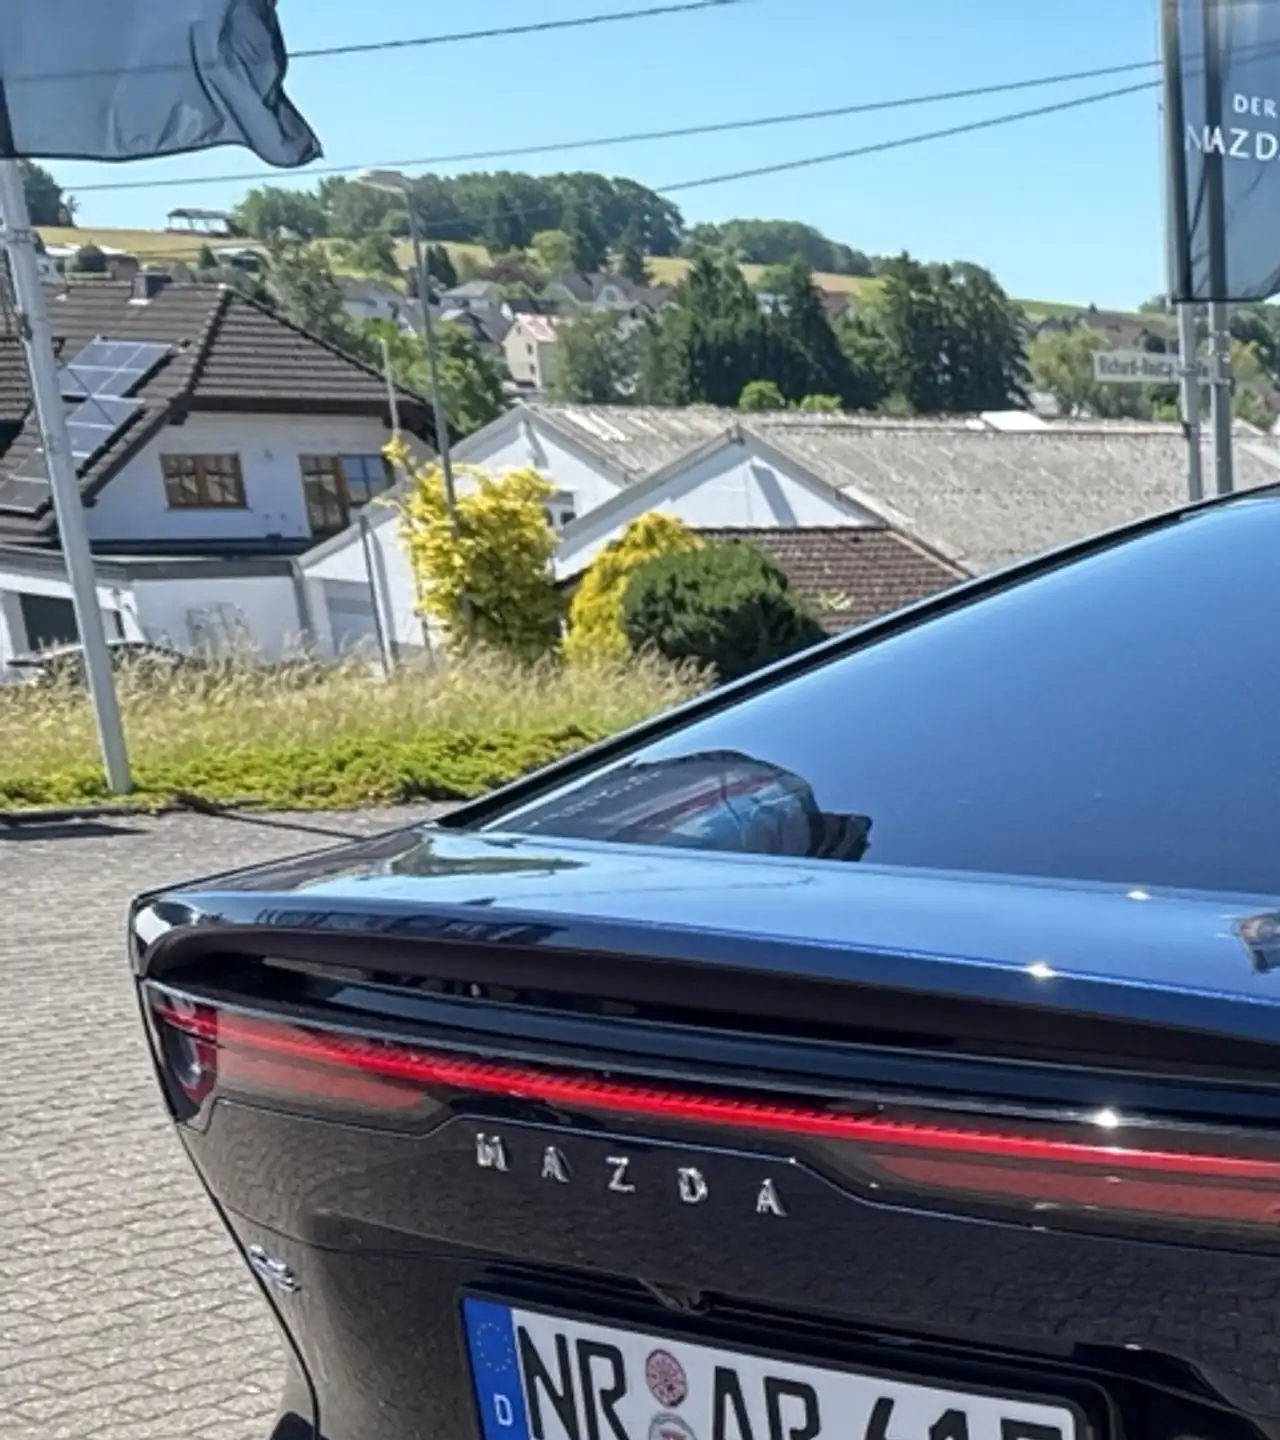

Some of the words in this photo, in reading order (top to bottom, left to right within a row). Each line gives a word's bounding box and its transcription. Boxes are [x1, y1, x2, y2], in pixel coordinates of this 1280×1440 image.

[1234, 93, 1277, 119] DER
[476, 1132, 788, 1217] MAZDA
[494, 1395, 514, 1427] D
